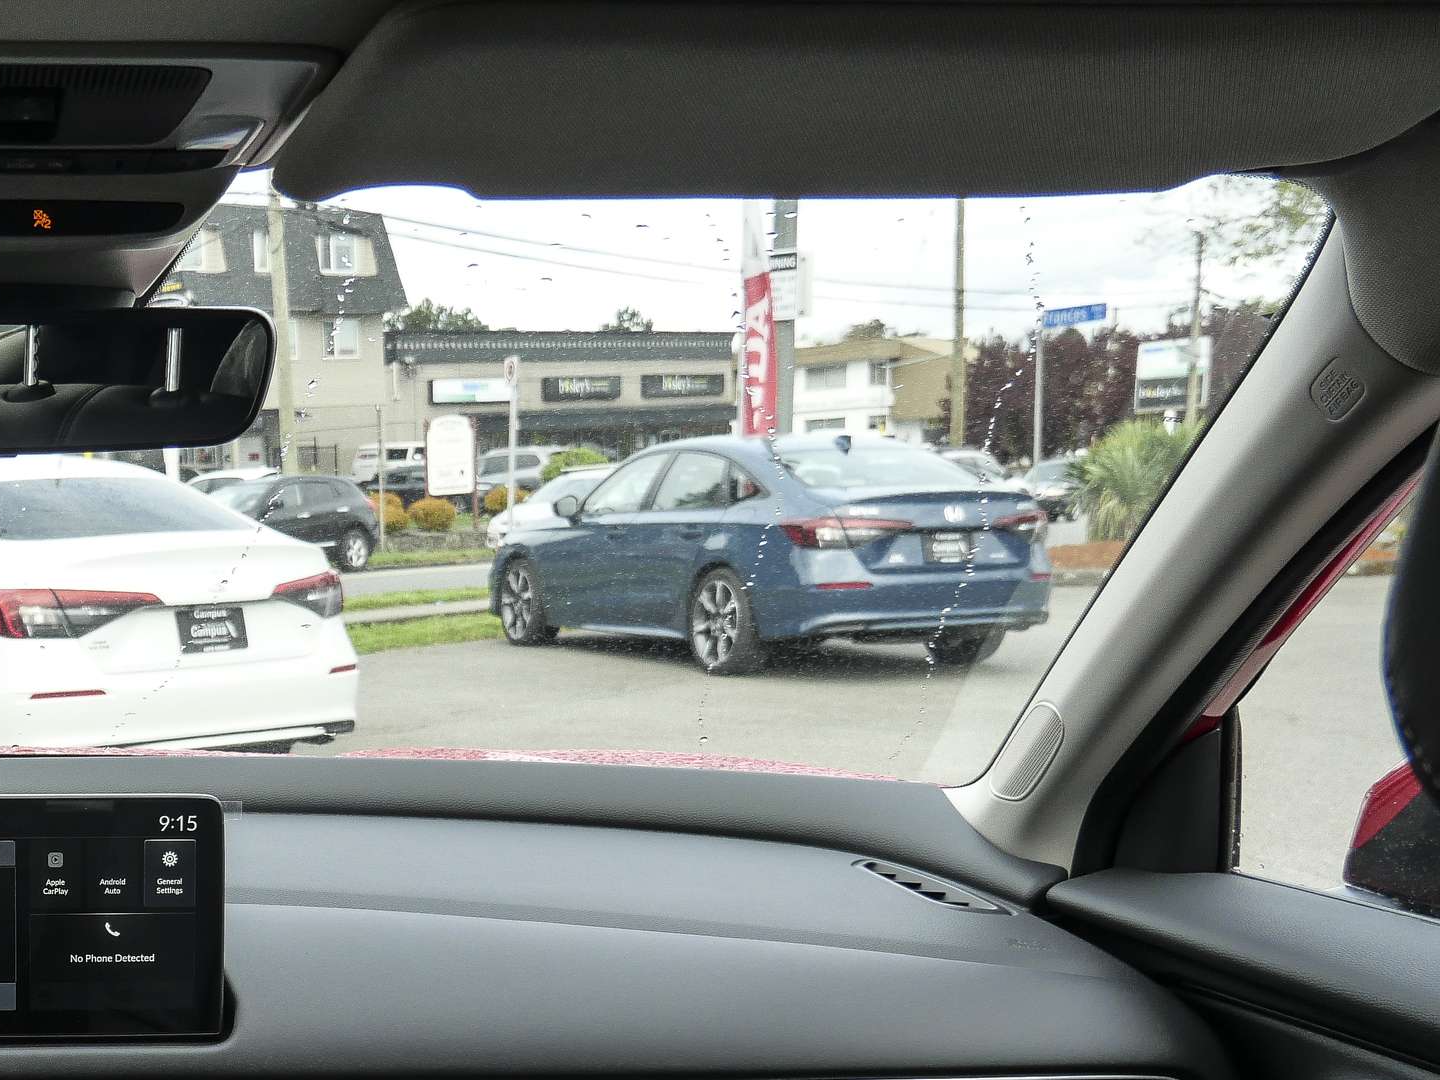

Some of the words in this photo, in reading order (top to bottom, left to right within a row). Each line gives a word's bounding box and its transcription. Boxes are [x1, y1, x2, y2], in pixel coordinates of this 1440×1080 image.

[159, 815, 198, 832] 9:15
[45, 878, 66, 888] Apple
[99, 877, 126, 887] Android
[156, 877, 183, 886] General
[42, 887, 69, 897] CarPlay
[104, 887, 121, 895] Auto
[156, 887, 184, 897] Settings
[69, 953, 82, 963] No
[84, 953, 113, 963] Phone
[115, 953, 155, 963] Detected
